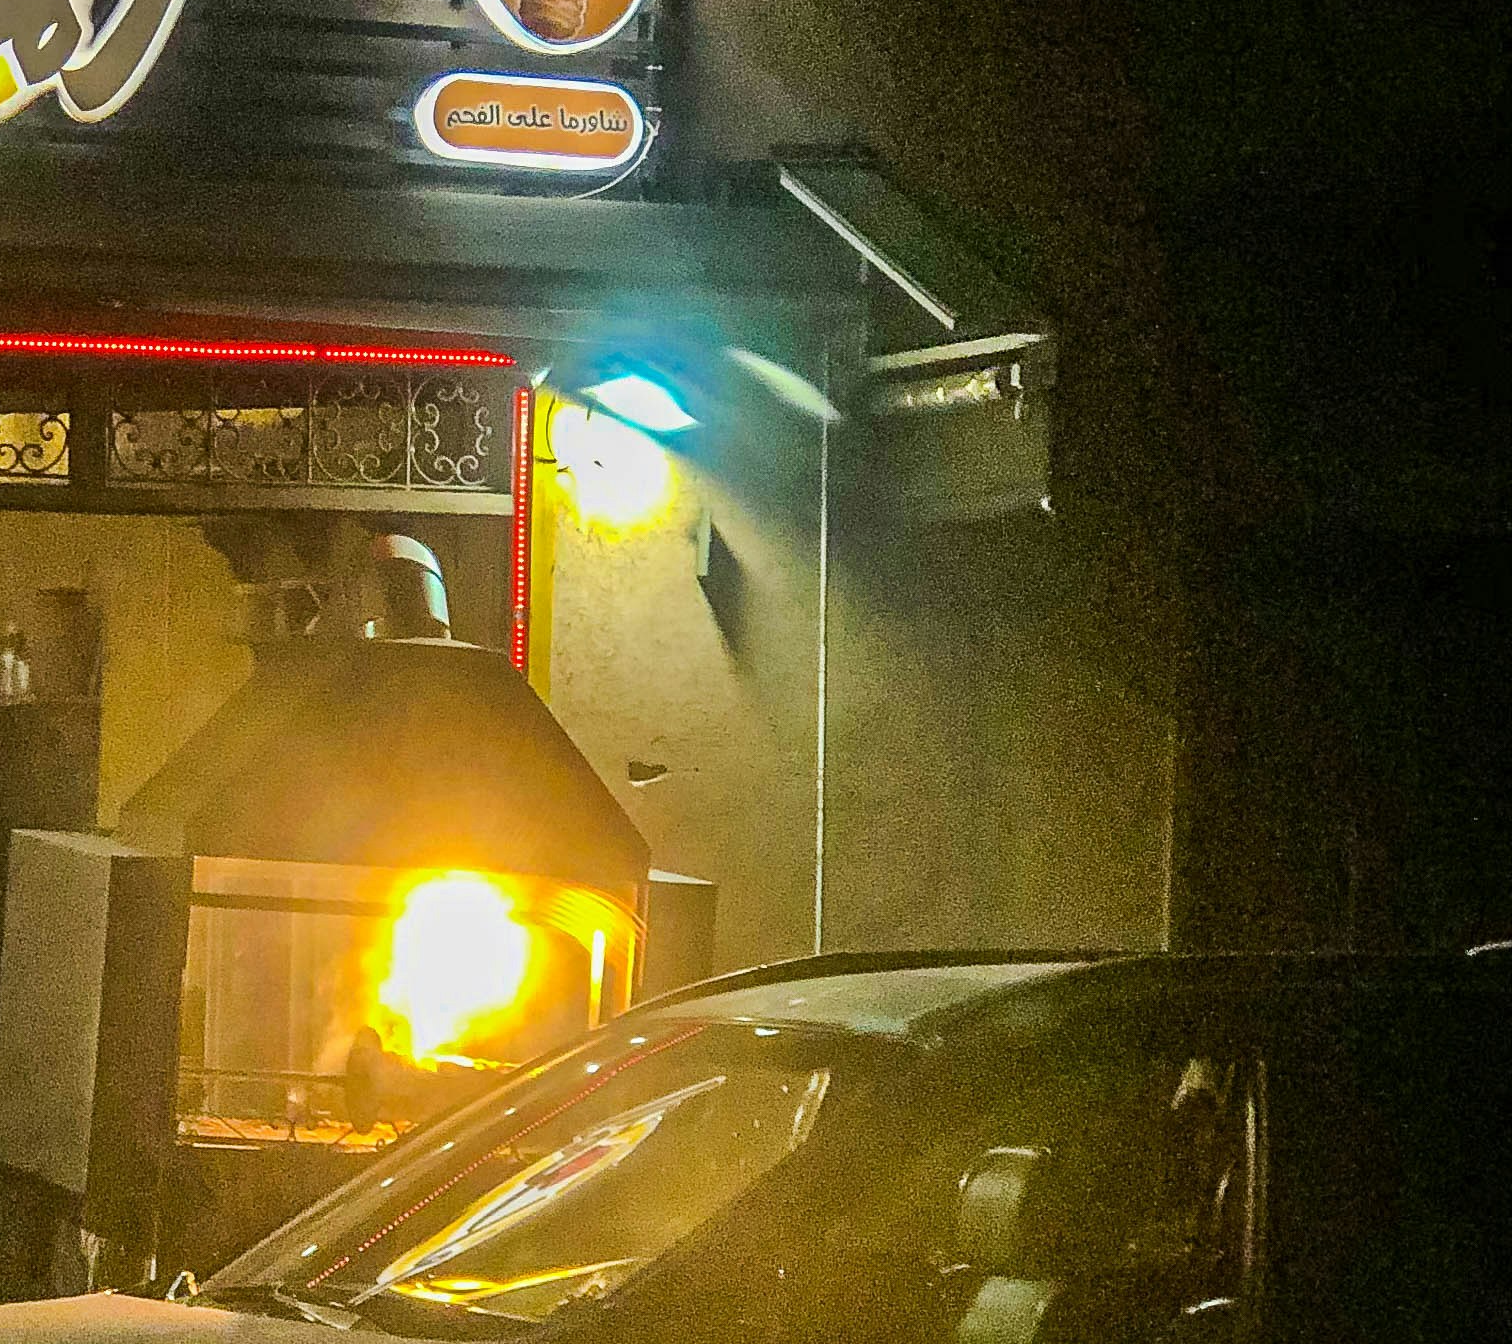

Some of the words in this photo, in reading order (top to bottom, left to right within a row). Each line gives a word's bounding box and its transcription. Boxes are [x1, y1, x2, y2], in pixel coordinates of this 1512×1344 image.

[446, 104, 501, 128] الفحم
[507, 106, 553, 129] على
[559, 108, 628, 134] شاورما
